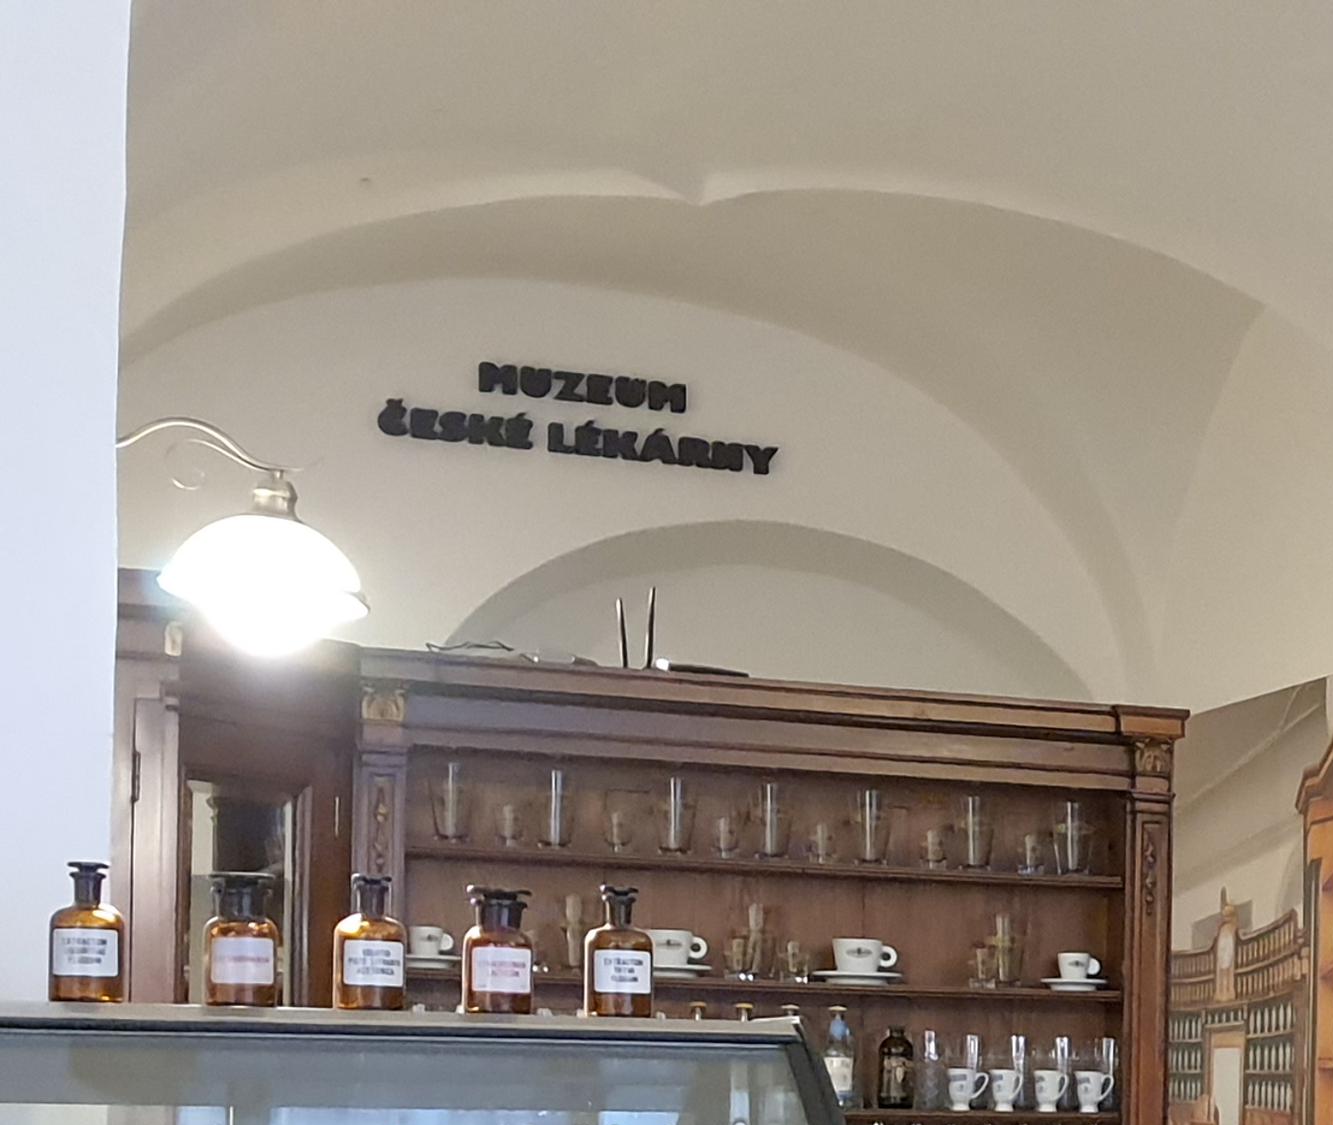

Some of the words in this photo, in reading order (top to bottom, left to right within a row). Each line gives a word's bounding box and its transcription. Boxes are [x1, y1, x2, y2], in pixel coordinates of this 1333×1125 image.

[478, 361, 686, 413] MUZEUM
[377, 398, 533, 449] ČESKÉ
[547, 419, 778, 474] LÉKÁRNY
